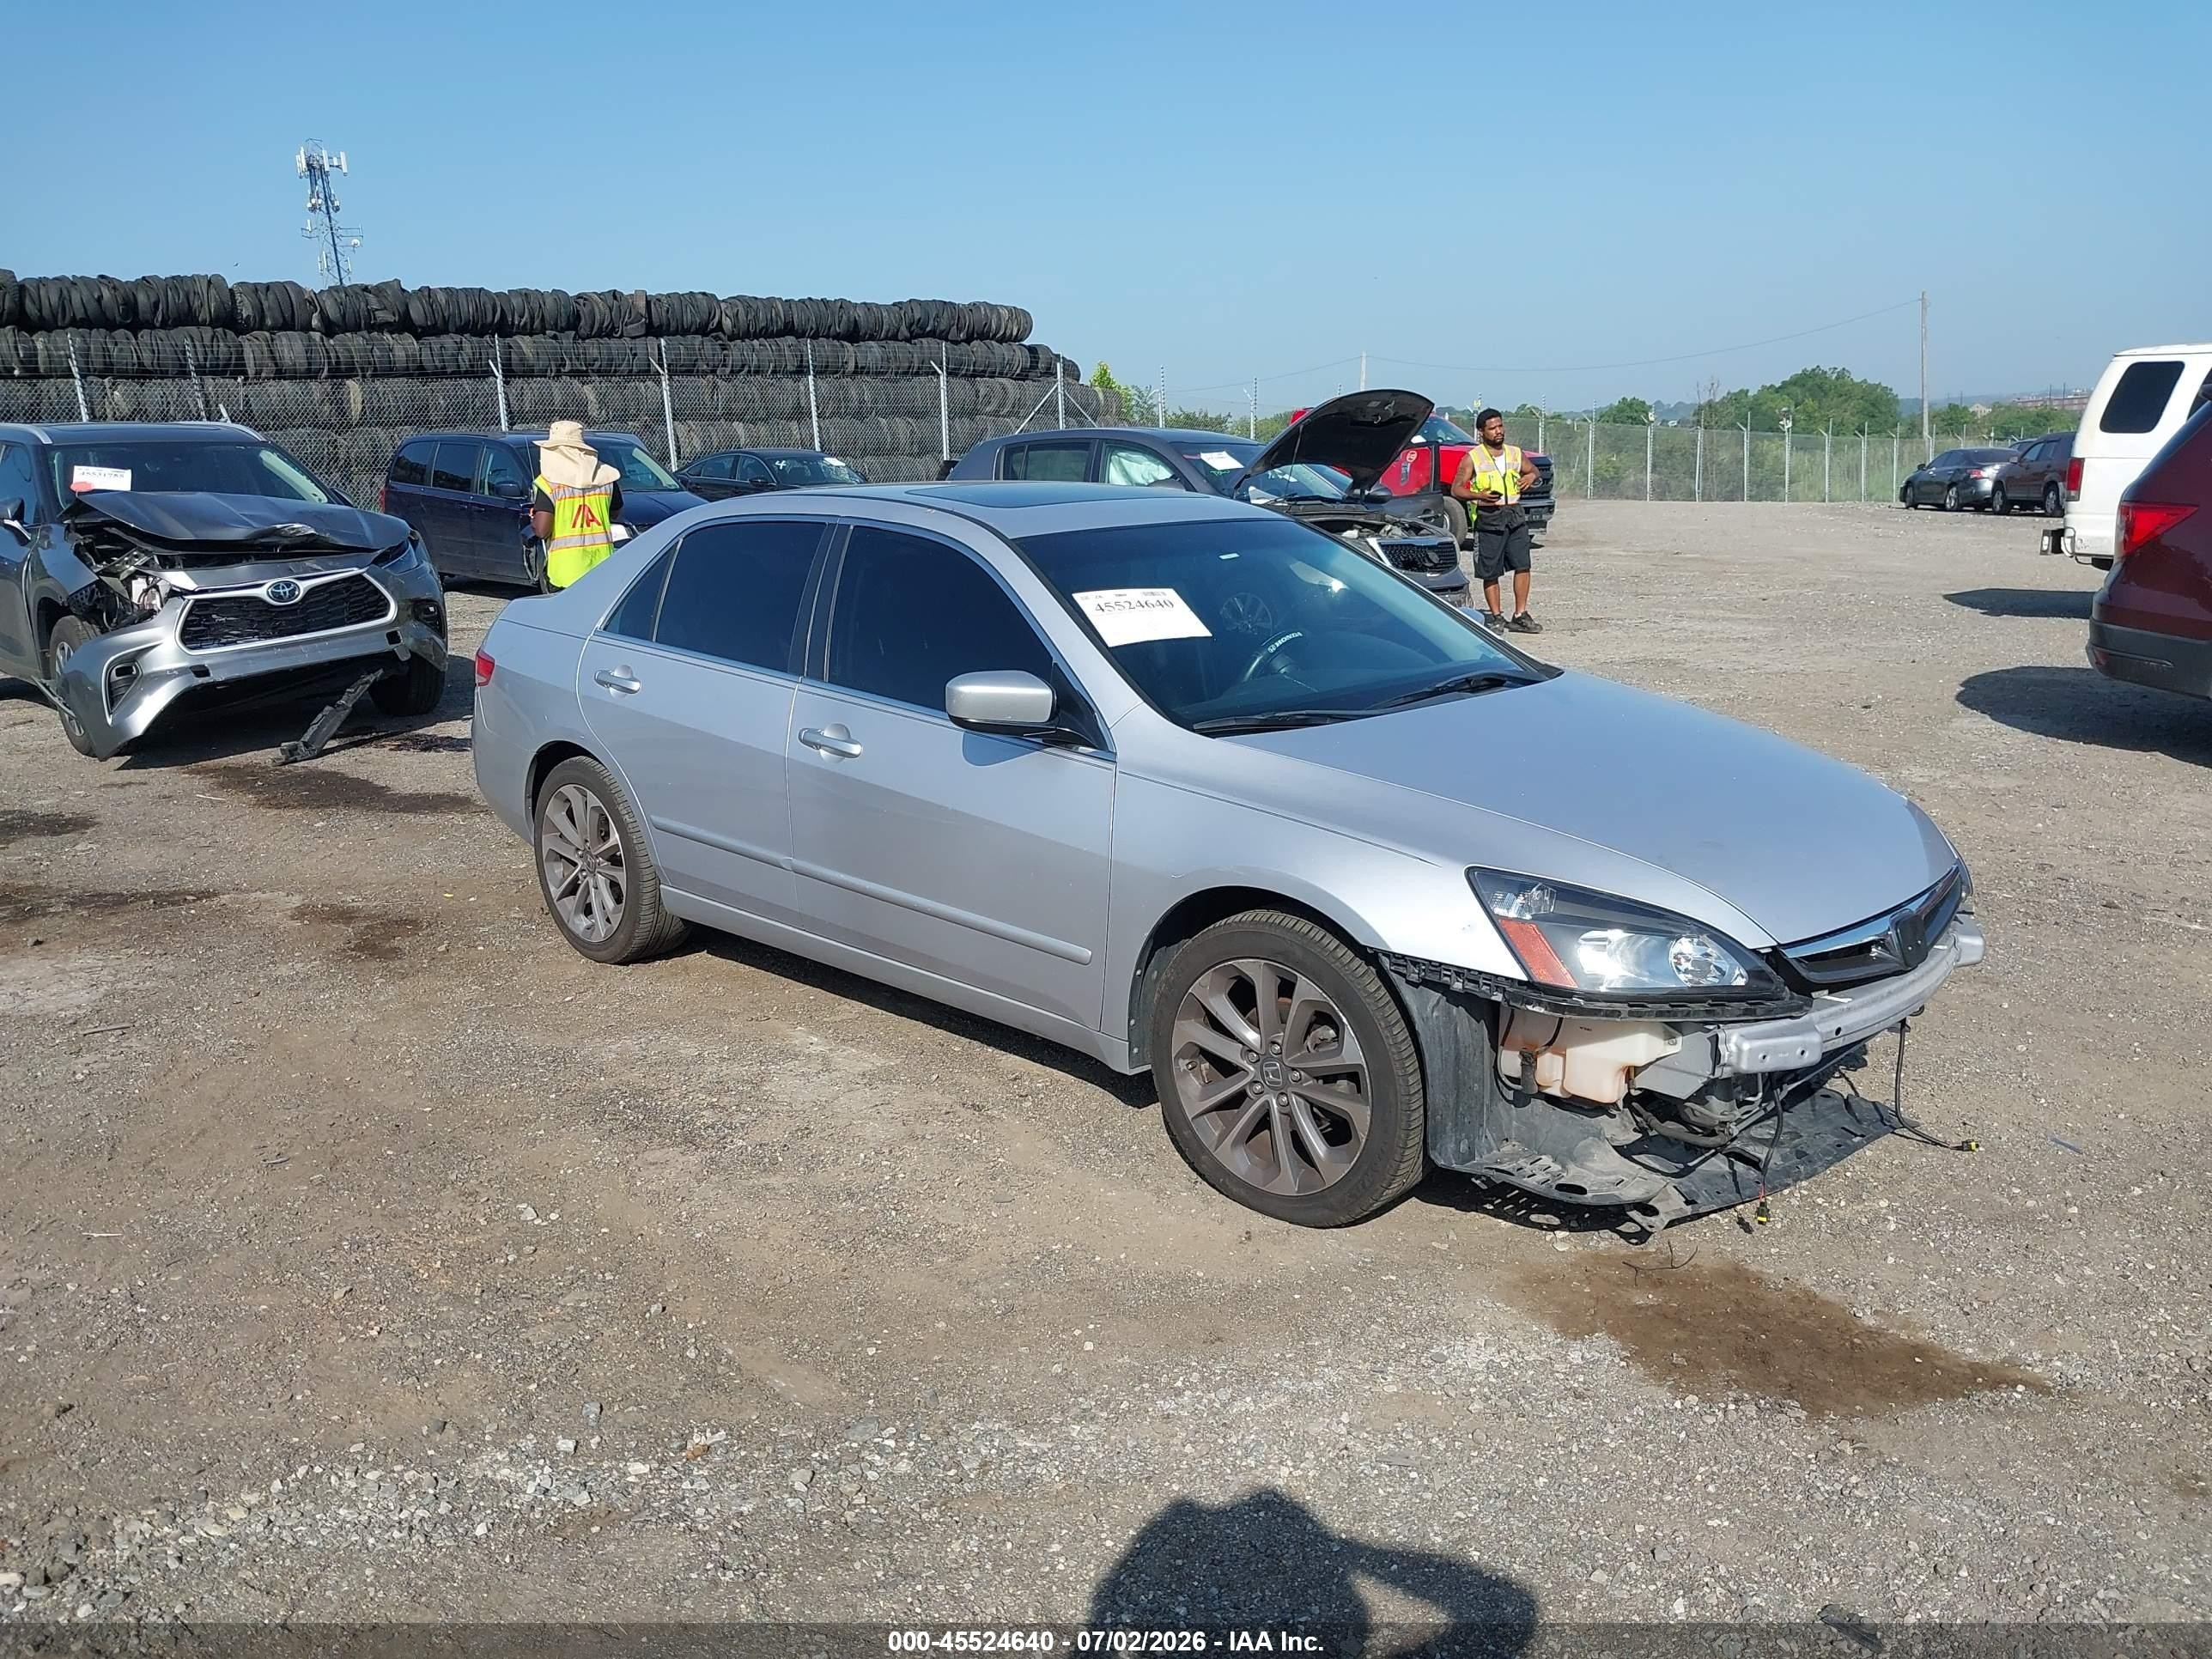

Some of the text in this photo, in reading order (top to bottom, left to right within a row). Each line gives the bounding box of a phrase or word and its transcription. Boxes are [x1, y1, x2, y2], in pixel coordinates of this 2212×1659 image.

[775, 460, 787, 470] 4
[1095, 599, 1174, 612] 45524640
[1274, 632, 1303, 647] HONDA
